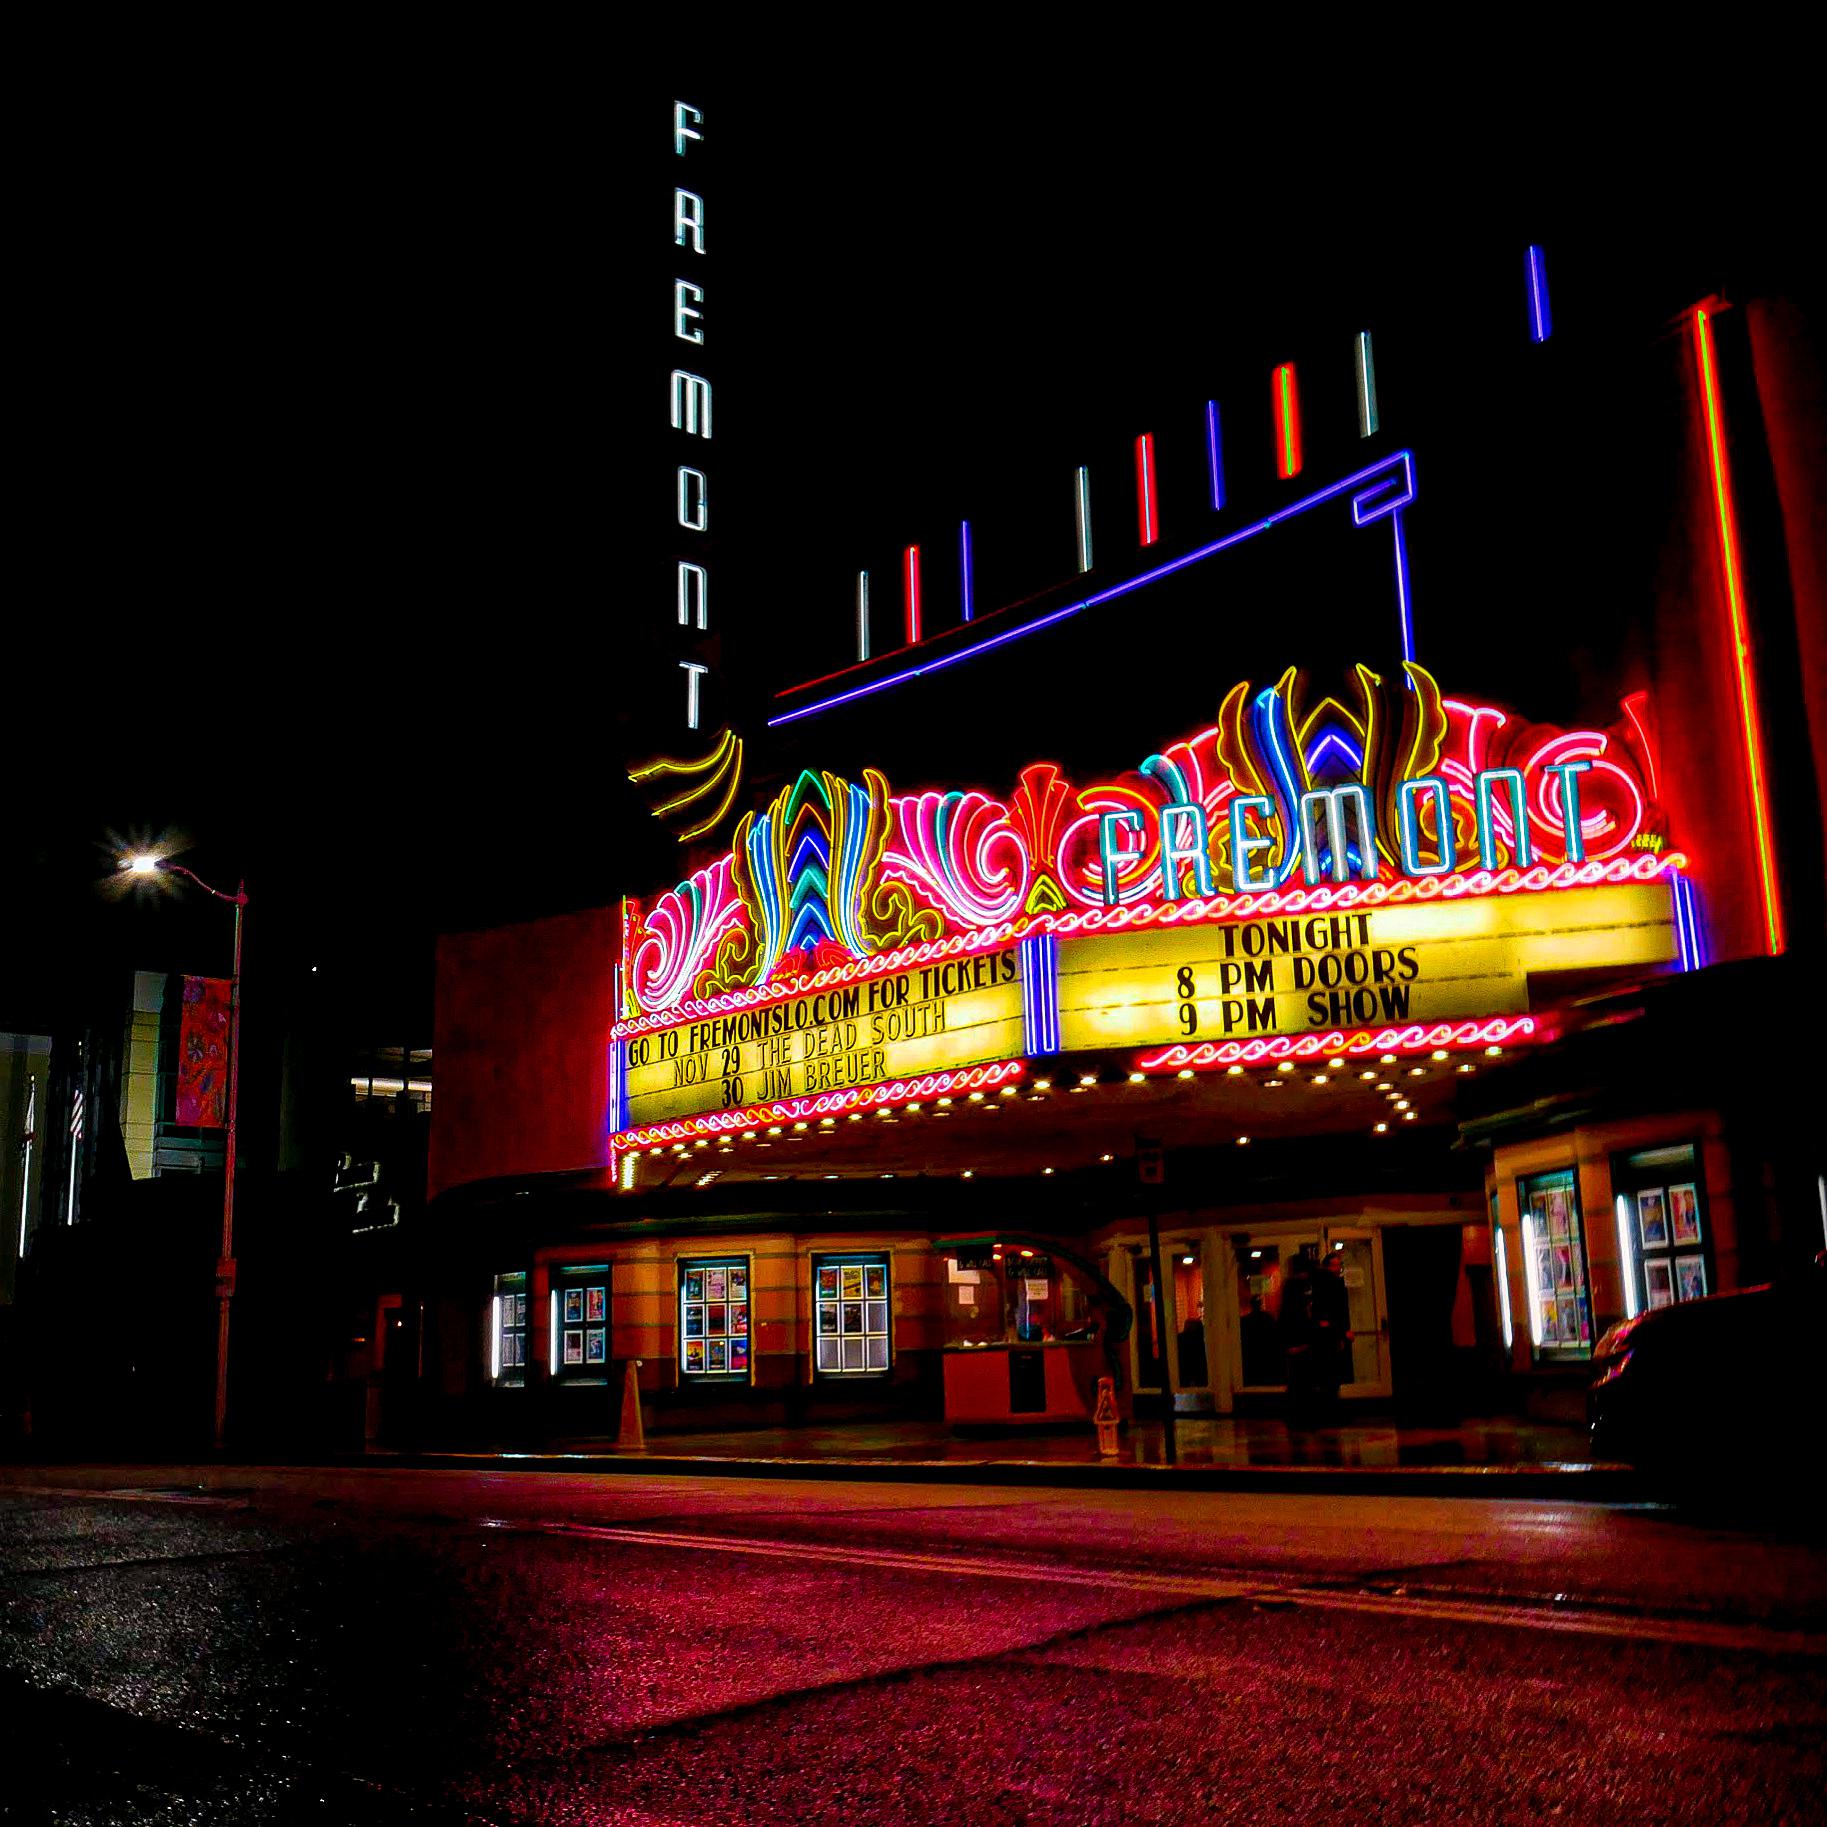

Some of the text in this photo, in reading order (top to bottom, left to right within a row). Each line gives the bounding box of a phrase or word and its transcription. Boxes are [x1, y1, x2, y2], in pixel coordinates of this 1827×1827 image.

[670, 98, 713, 731] FREMONT
[1100, 761, 1595, 906] FREMONT
[1218, 912, 1373, 957] TONIGHT
[628, 949, 1016, 1067] GO TO FREMONTSLO.COM FOR TICKETS
[1176, 946, 1419, 999] 8 PM DOORS
[674, 999, 947, 1087] NOV 29 THE DEAD SOUTH
[1179, 984, 1411, 1036] 9 PM SHOW
[721, 1048, 887, 1108] 30 JIM BREUER
